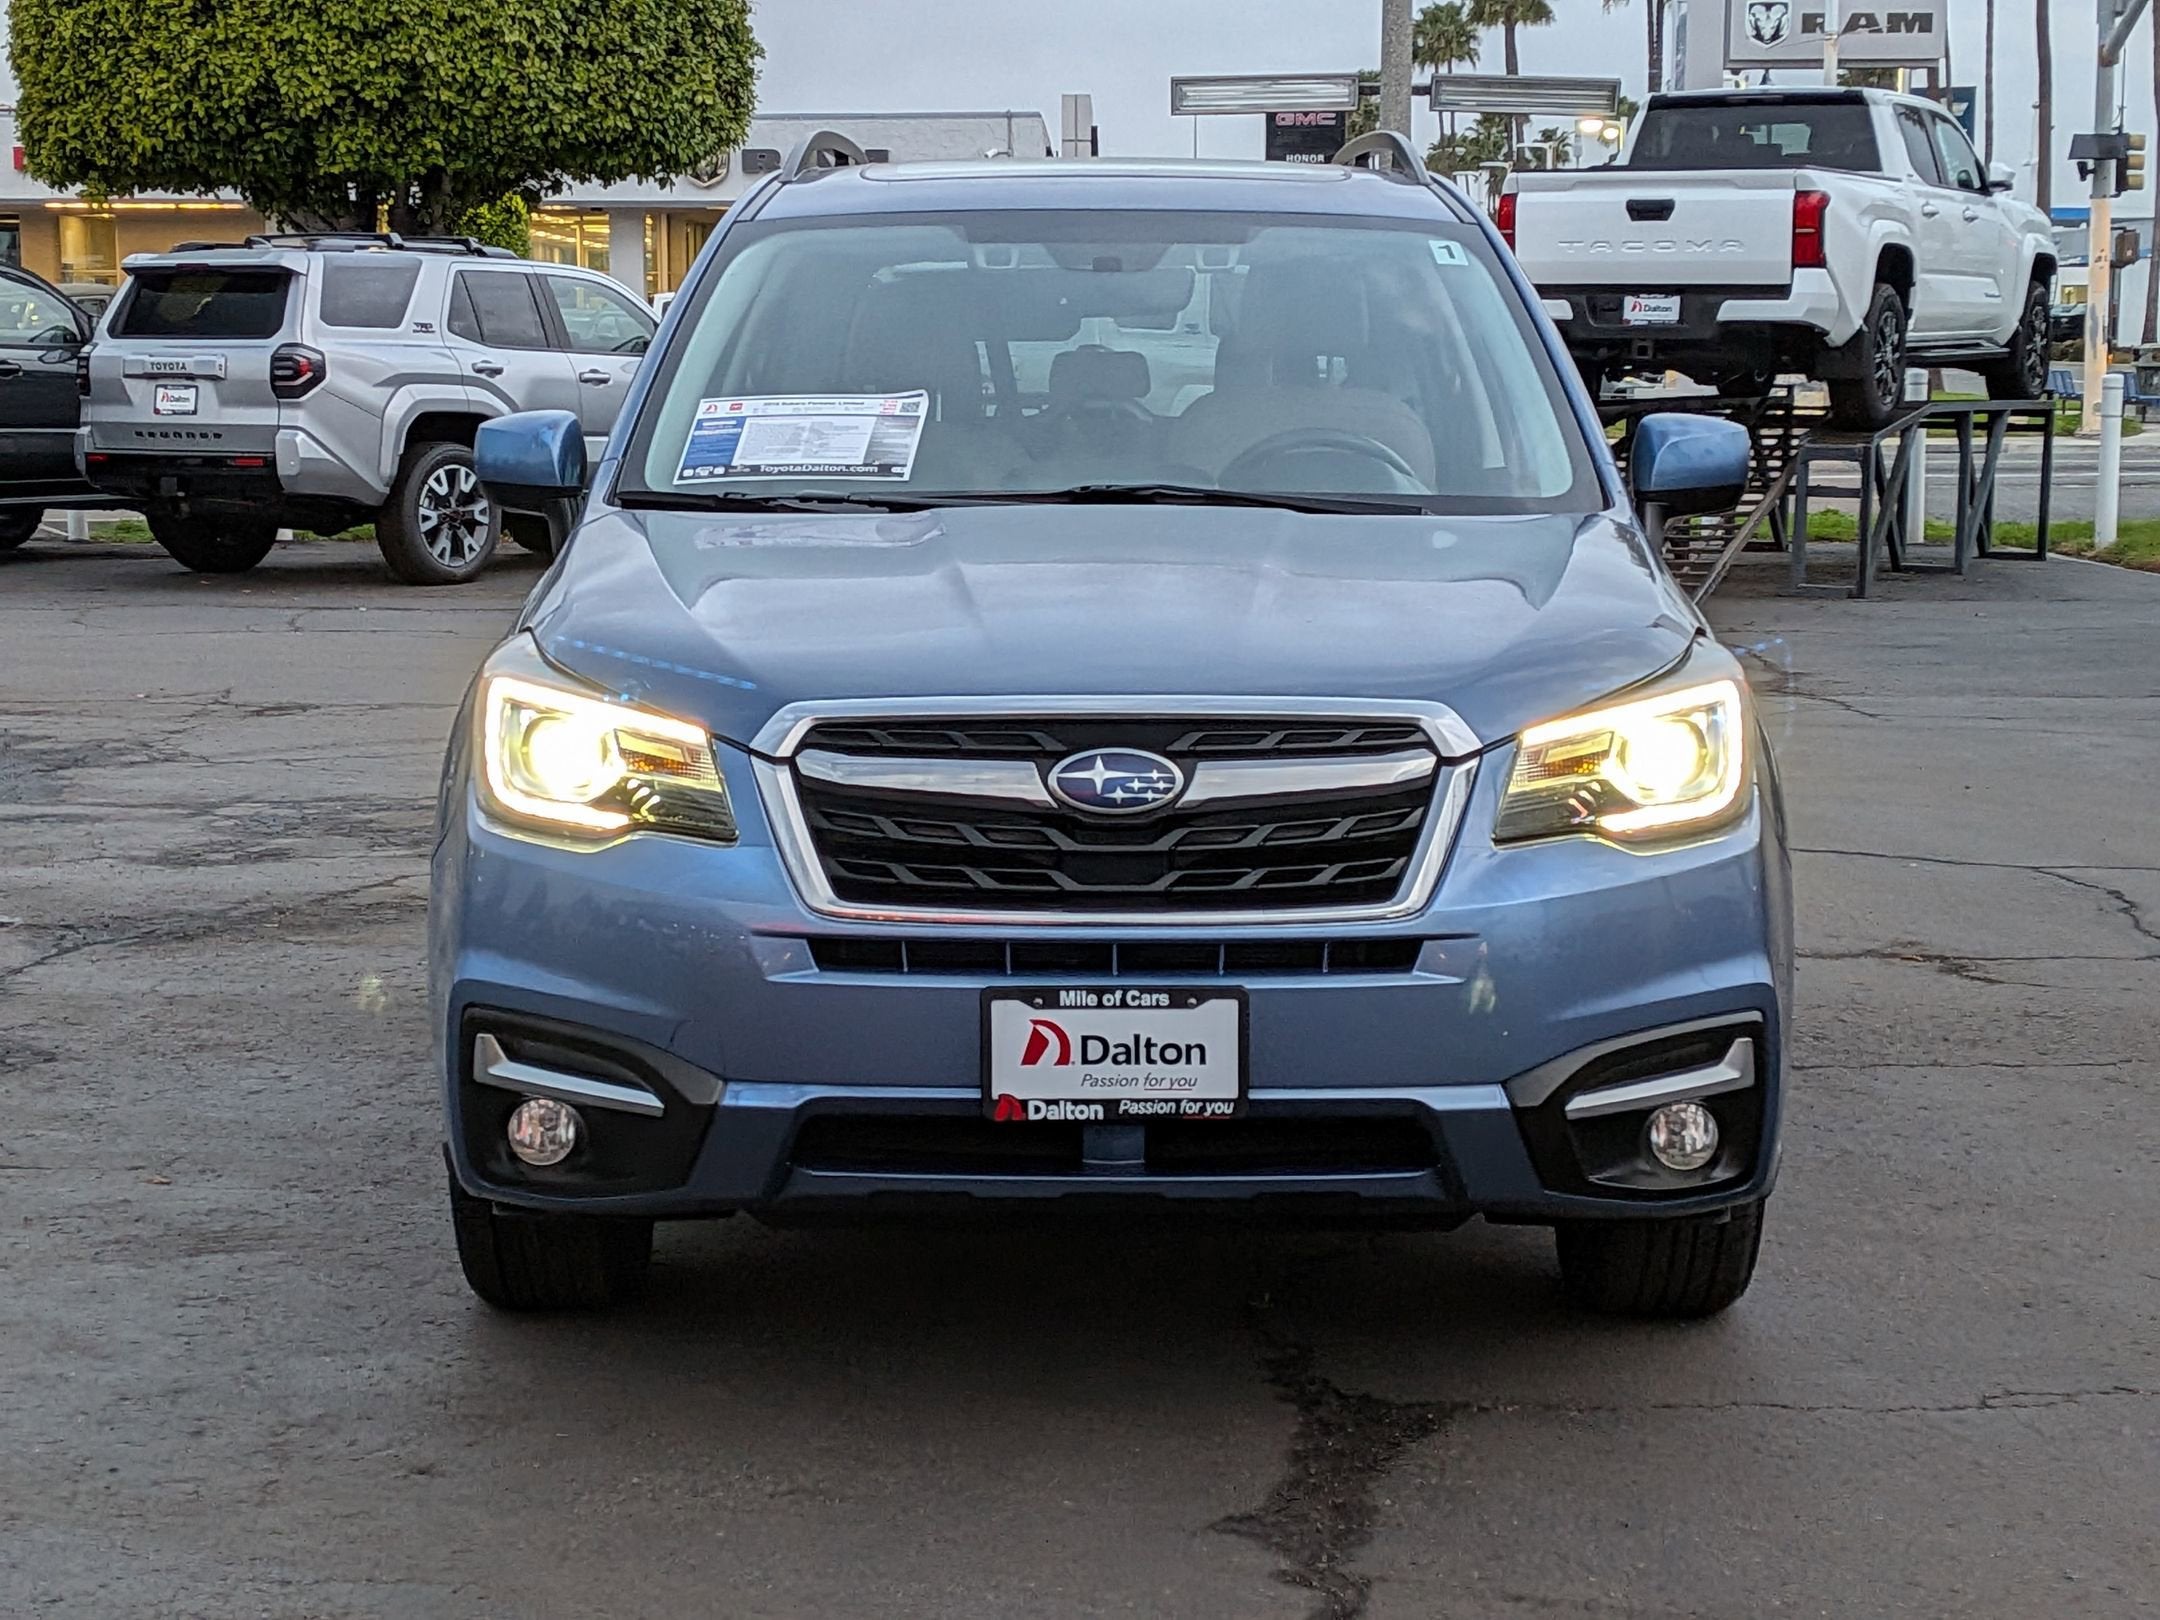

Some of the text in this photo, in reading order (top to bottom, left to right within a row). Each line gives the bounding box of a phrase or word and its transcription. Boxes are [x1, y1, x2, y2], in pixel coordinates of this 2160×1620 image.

[1801, 12, 1933, 34] RAM
[1275, 112, 1337, 126] GMC
[1557, 239, 1745, 253] TACOMA
[150, 361, 187, 371] TOYOTA
[760, 463, 879, 474] ToyotaDalton.com
[1059, 990, 1170, 1006] Mile of Cars
[1080, 1034, 1206, 1065] Dalton
[1080, 1072, 1198, 1089] Passion for you
[1028, 1100, 1104, 1120] Dalton
[1118, 1099, 1234, 1117] Passion for you
